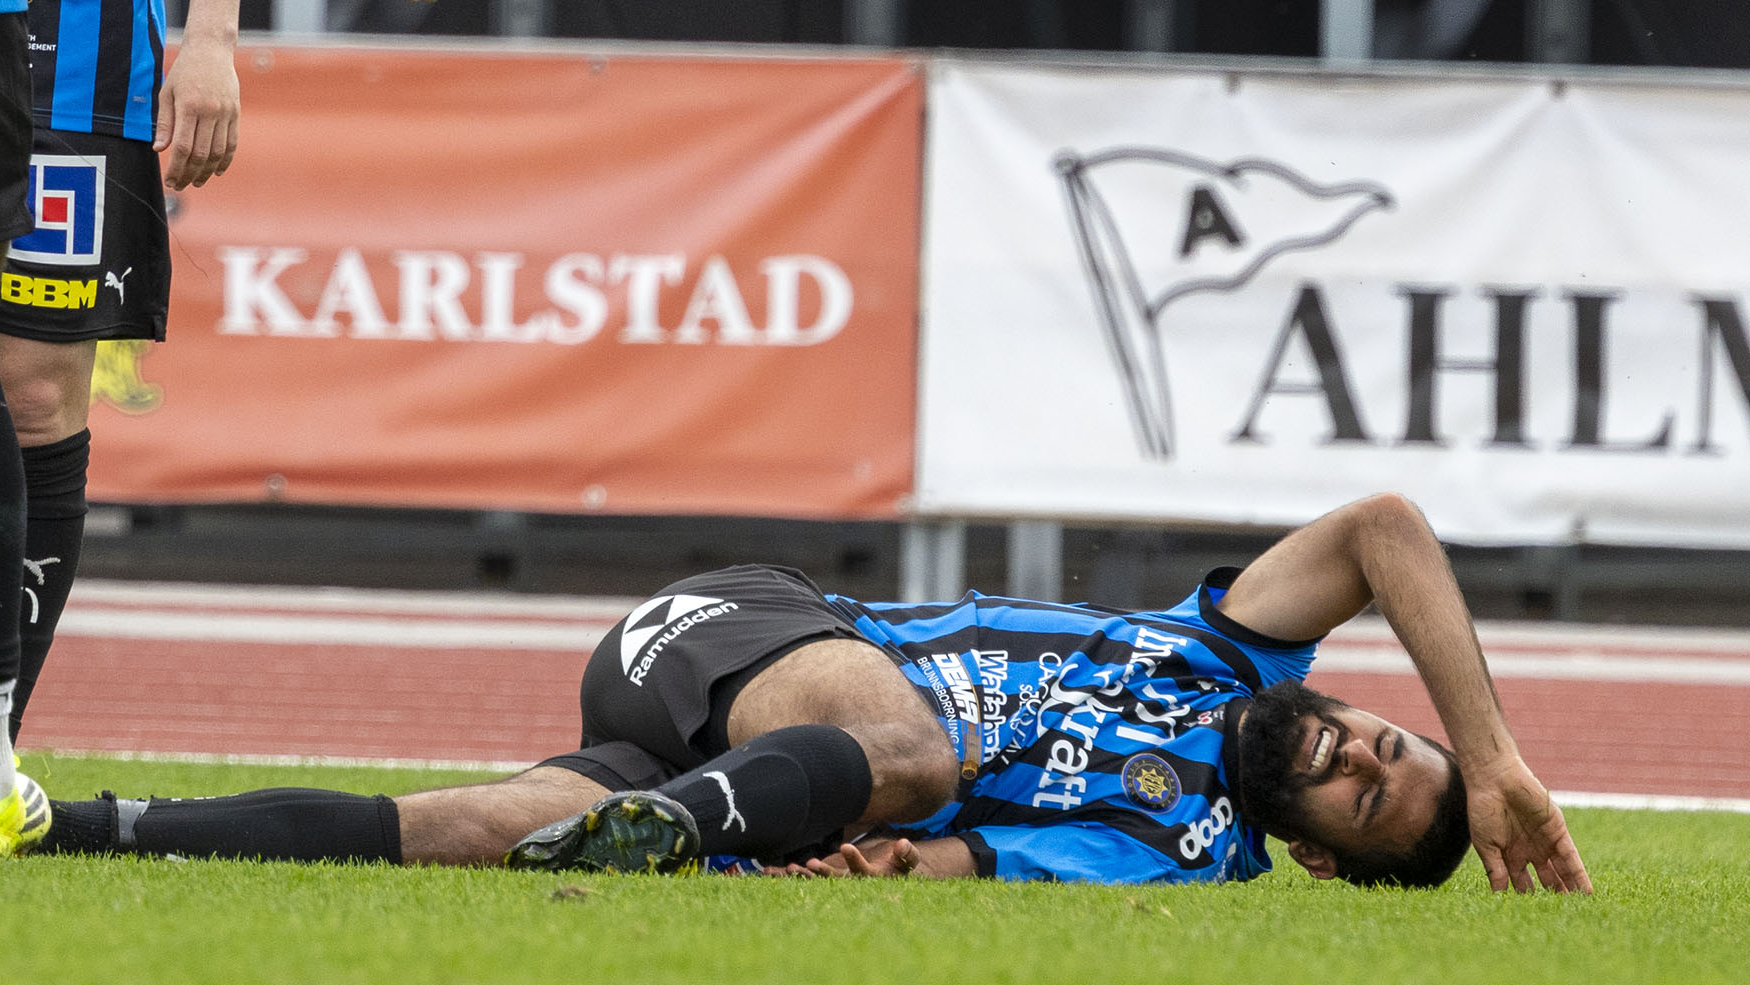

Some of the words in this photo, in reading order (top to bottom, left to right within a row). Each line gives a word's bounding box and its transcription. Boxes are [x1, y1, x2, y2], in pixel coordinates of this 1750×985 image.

[1178, 186, 1246, 260] A
[0, 272, 98, 310] BBM
[216, 244, 854, 347] KARLSTAD
[630, 602, 739, 687] Ramudden
[1180, 796, 1234, 860] coop
